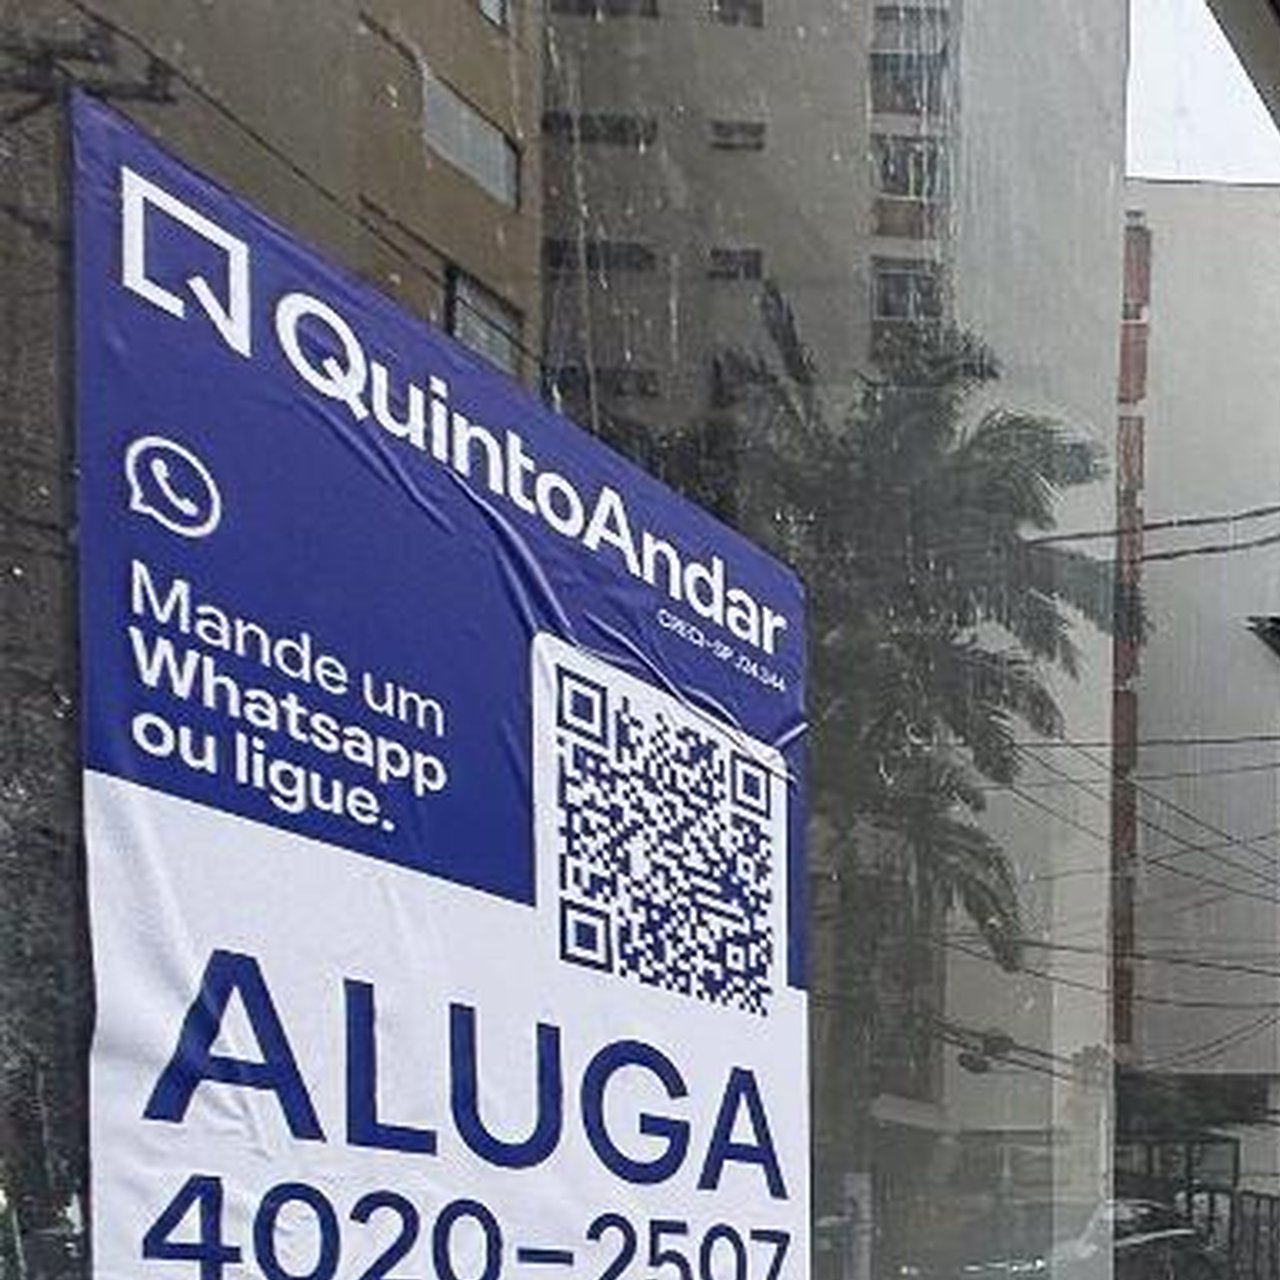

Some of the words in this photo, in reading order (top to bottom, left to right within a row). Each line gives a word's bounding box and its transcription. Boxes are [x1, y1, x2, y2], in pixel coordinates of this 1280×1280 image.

[276, 292, 788, 655] QuintoAndar
[128, 625, 448, 798] Whatsapp
[132, 558, 348, 695] Mande
[362, 671, 445, 738] um
[132, 712, 217, 774] ou
[236, 731, 395, 832] ligue.
[141, 949, 790, 1200] ALUGA
